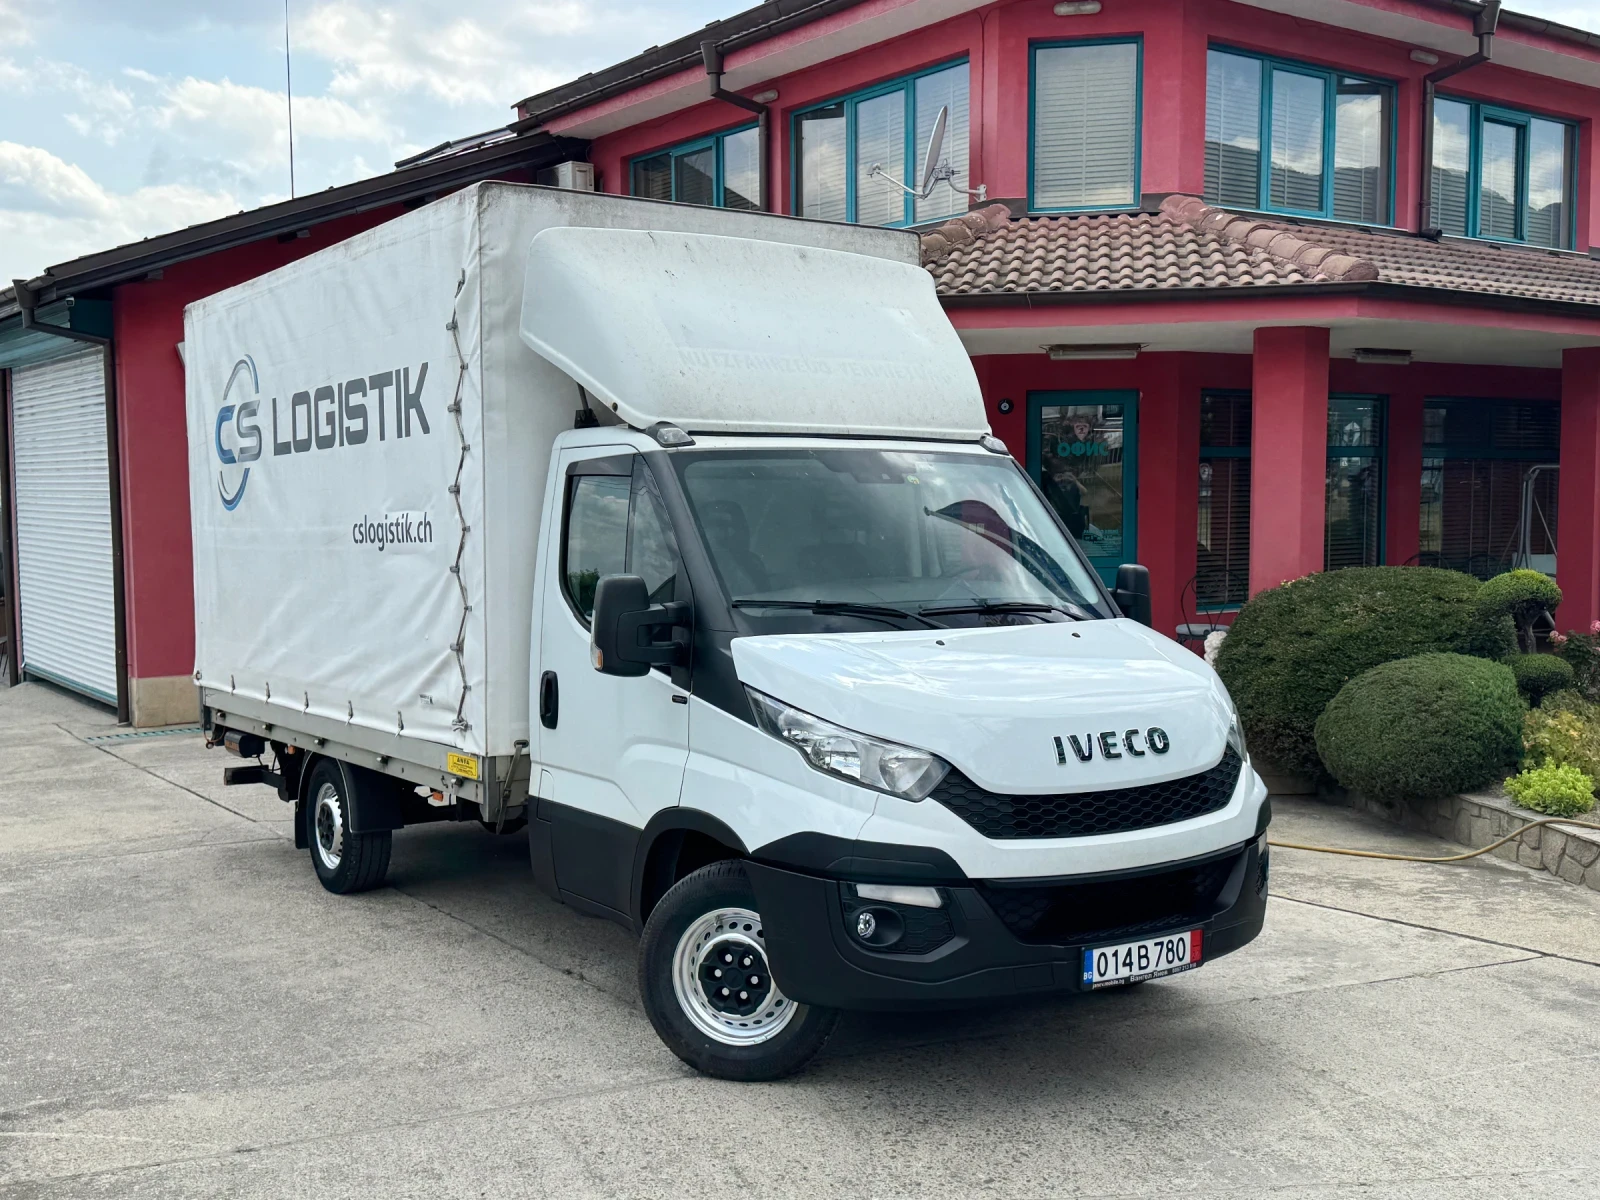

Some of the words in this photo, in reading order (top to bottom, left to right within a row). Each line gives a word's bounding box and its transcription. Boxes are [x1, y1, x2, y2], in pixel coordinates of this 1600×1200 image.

[214, 399, 262, 465] CS
[272, 361, 431, 456] LOGISTIK
[1057, 441, 1109, 458] ОФИС
[352, 512, 433, 552] cslogistik.ch
[1051, 725, 1170, 764] IVECO
[1083, 971, 1093, 981] BG
[1097, 937, 1186, 978] 014B780
